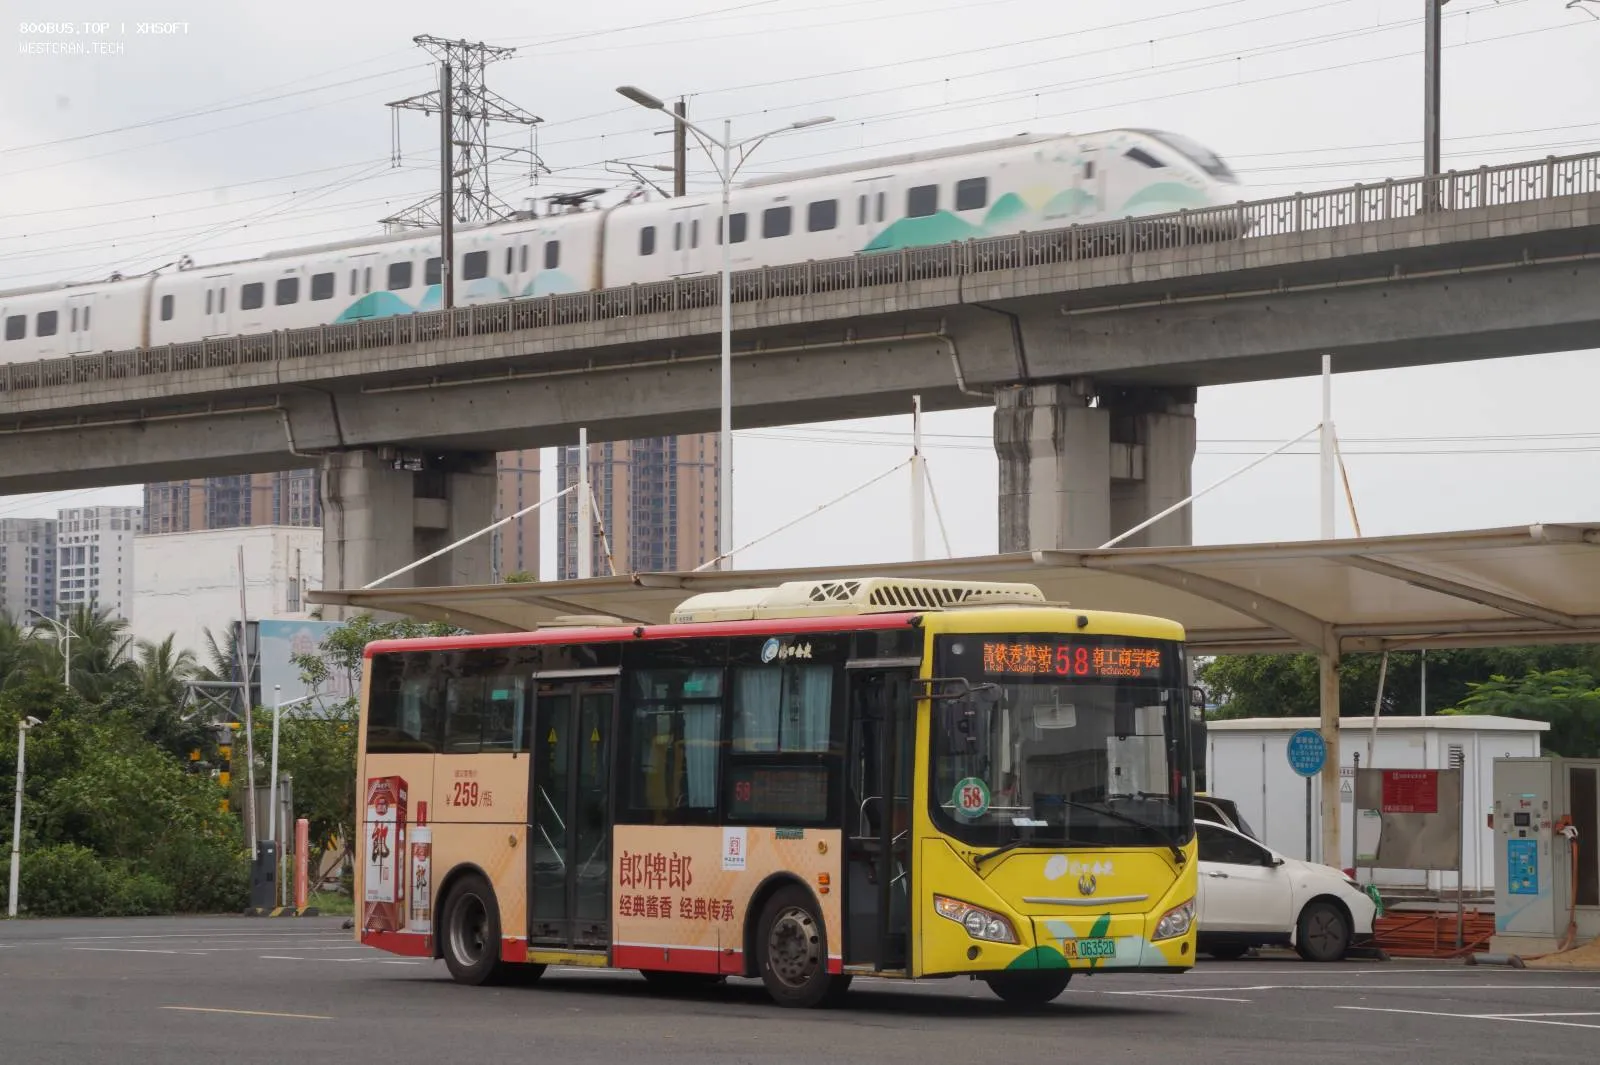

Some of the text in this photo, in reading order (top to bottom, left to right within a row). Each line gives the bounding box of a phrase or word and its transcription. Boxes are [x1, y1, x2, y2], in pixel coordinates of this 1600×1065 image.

[1056, 646, 1089, 675] 58
[963, 786, 982, 808] 58
[619, 850, 693, 892] 郎牌郎
[619, 894, 735, 922] 经典酱香 经典传承
